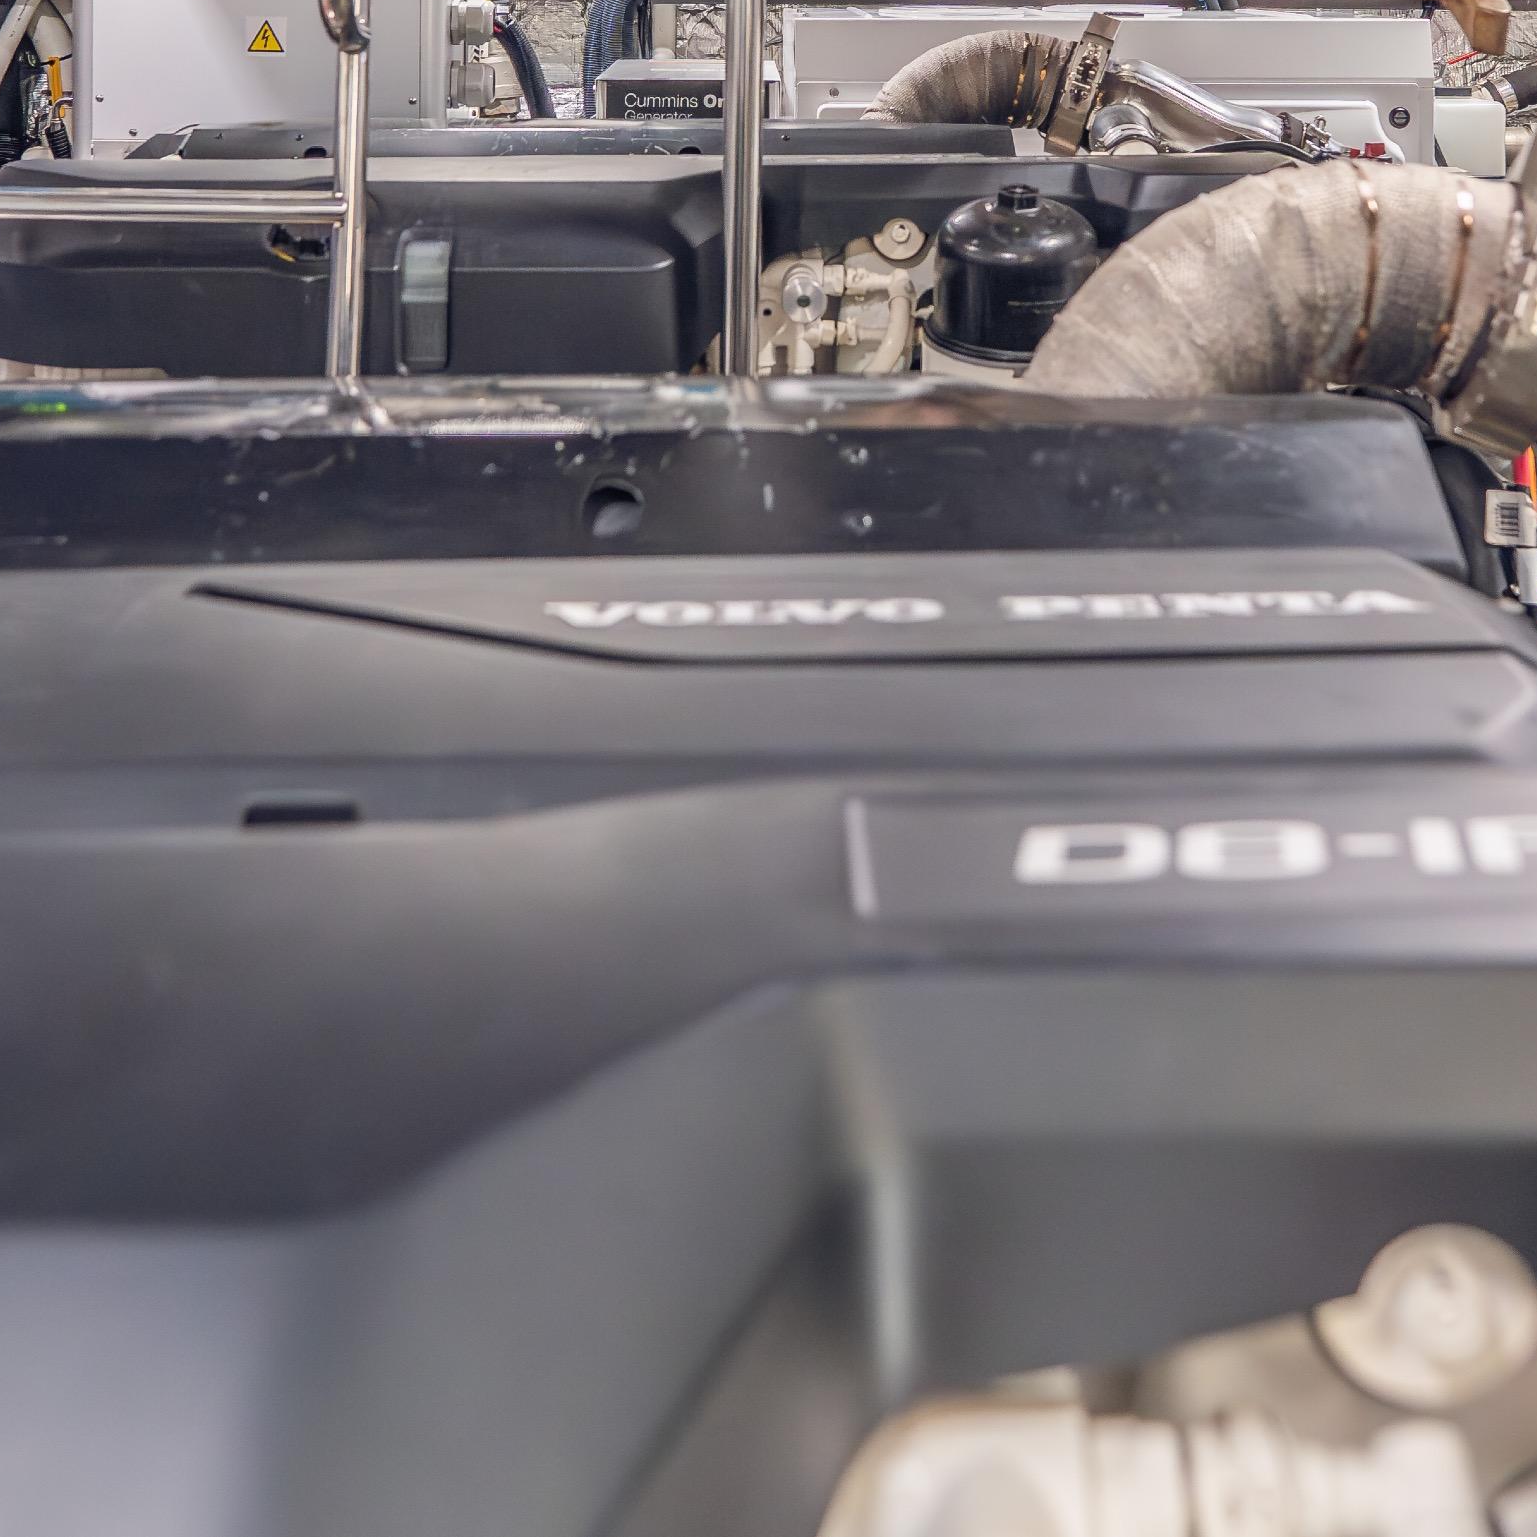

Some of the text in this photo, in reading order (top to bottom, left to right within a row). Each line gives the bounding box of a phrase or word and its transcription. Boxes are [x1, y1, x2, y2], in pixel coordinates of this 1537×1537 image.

[624, 92, 699, 108] Cummins
[544, 590, 1434, 629] VOLVO PENTA
